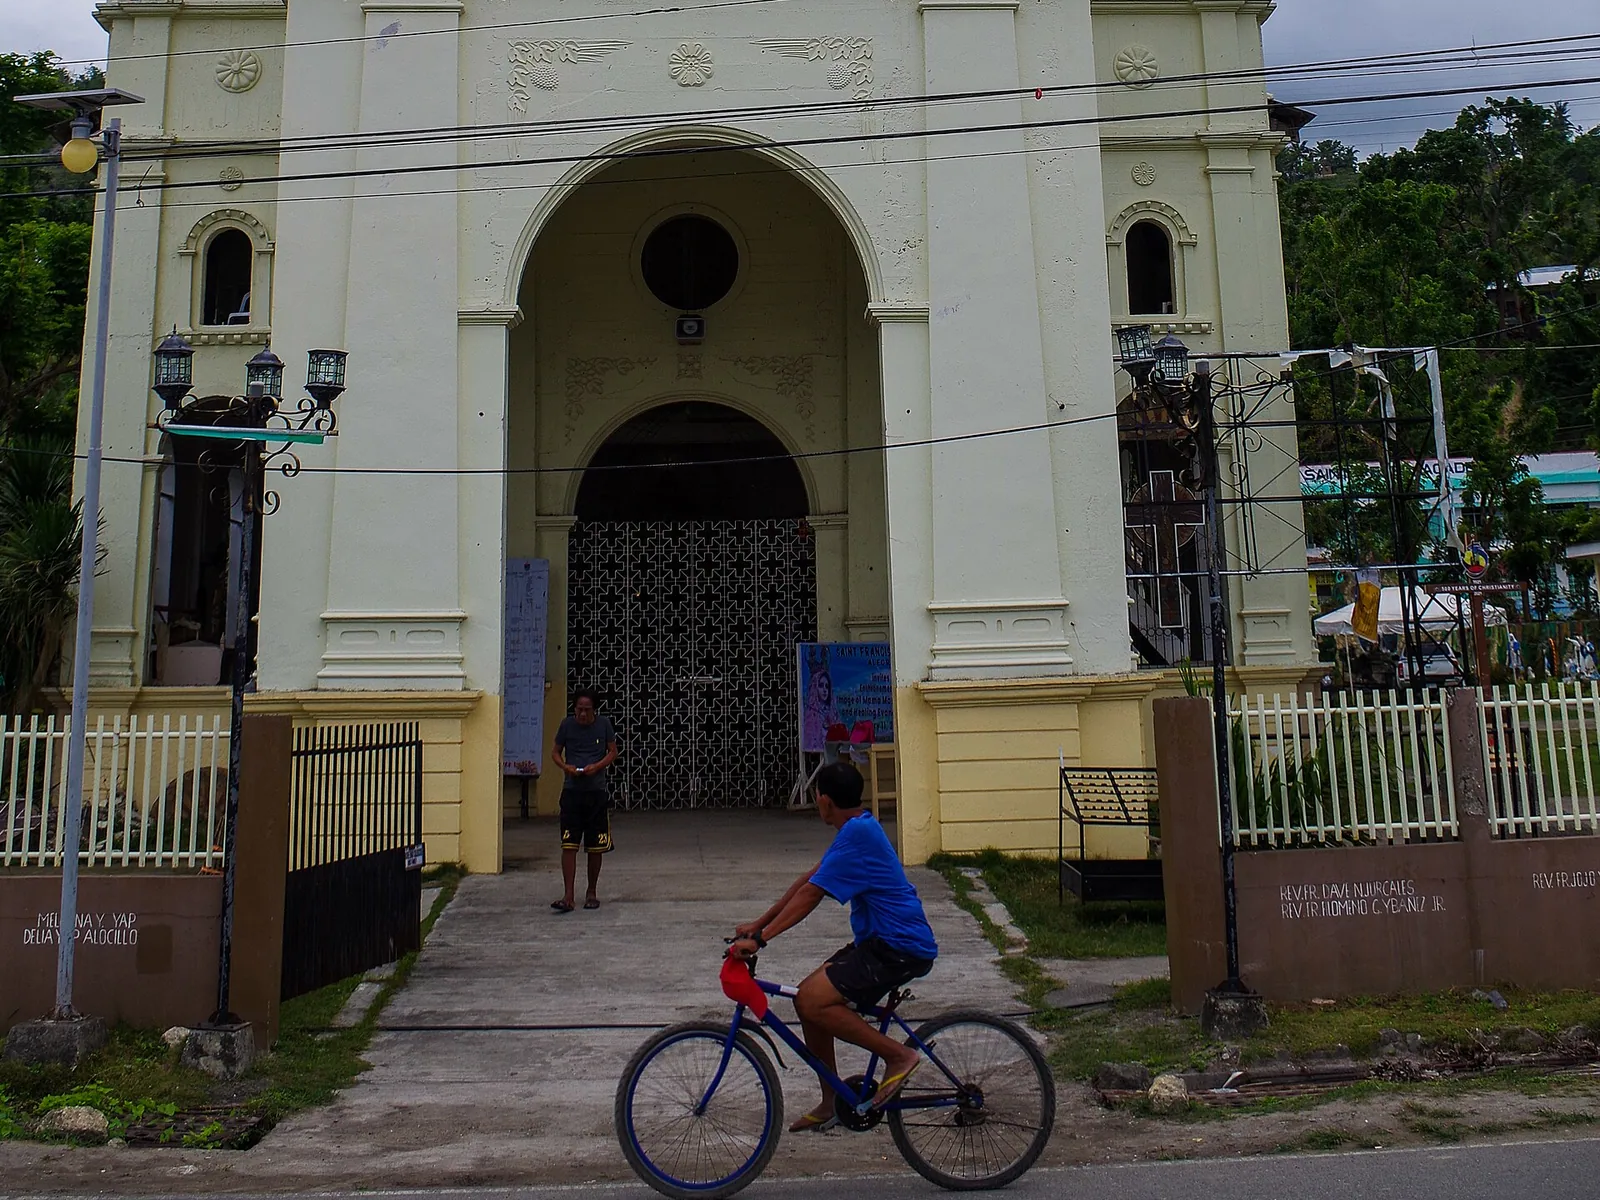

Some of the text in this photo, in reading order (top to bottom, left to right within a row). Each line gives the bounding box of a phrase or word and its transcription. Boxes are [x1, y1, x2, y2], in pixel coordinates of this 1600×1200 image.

[1322, 882, 1350, 899] DAVE
[36, 912, 93, 928] MELNA
[112, 912, 137, 929] YAP
[23, 928, 54, 945] DELIA
